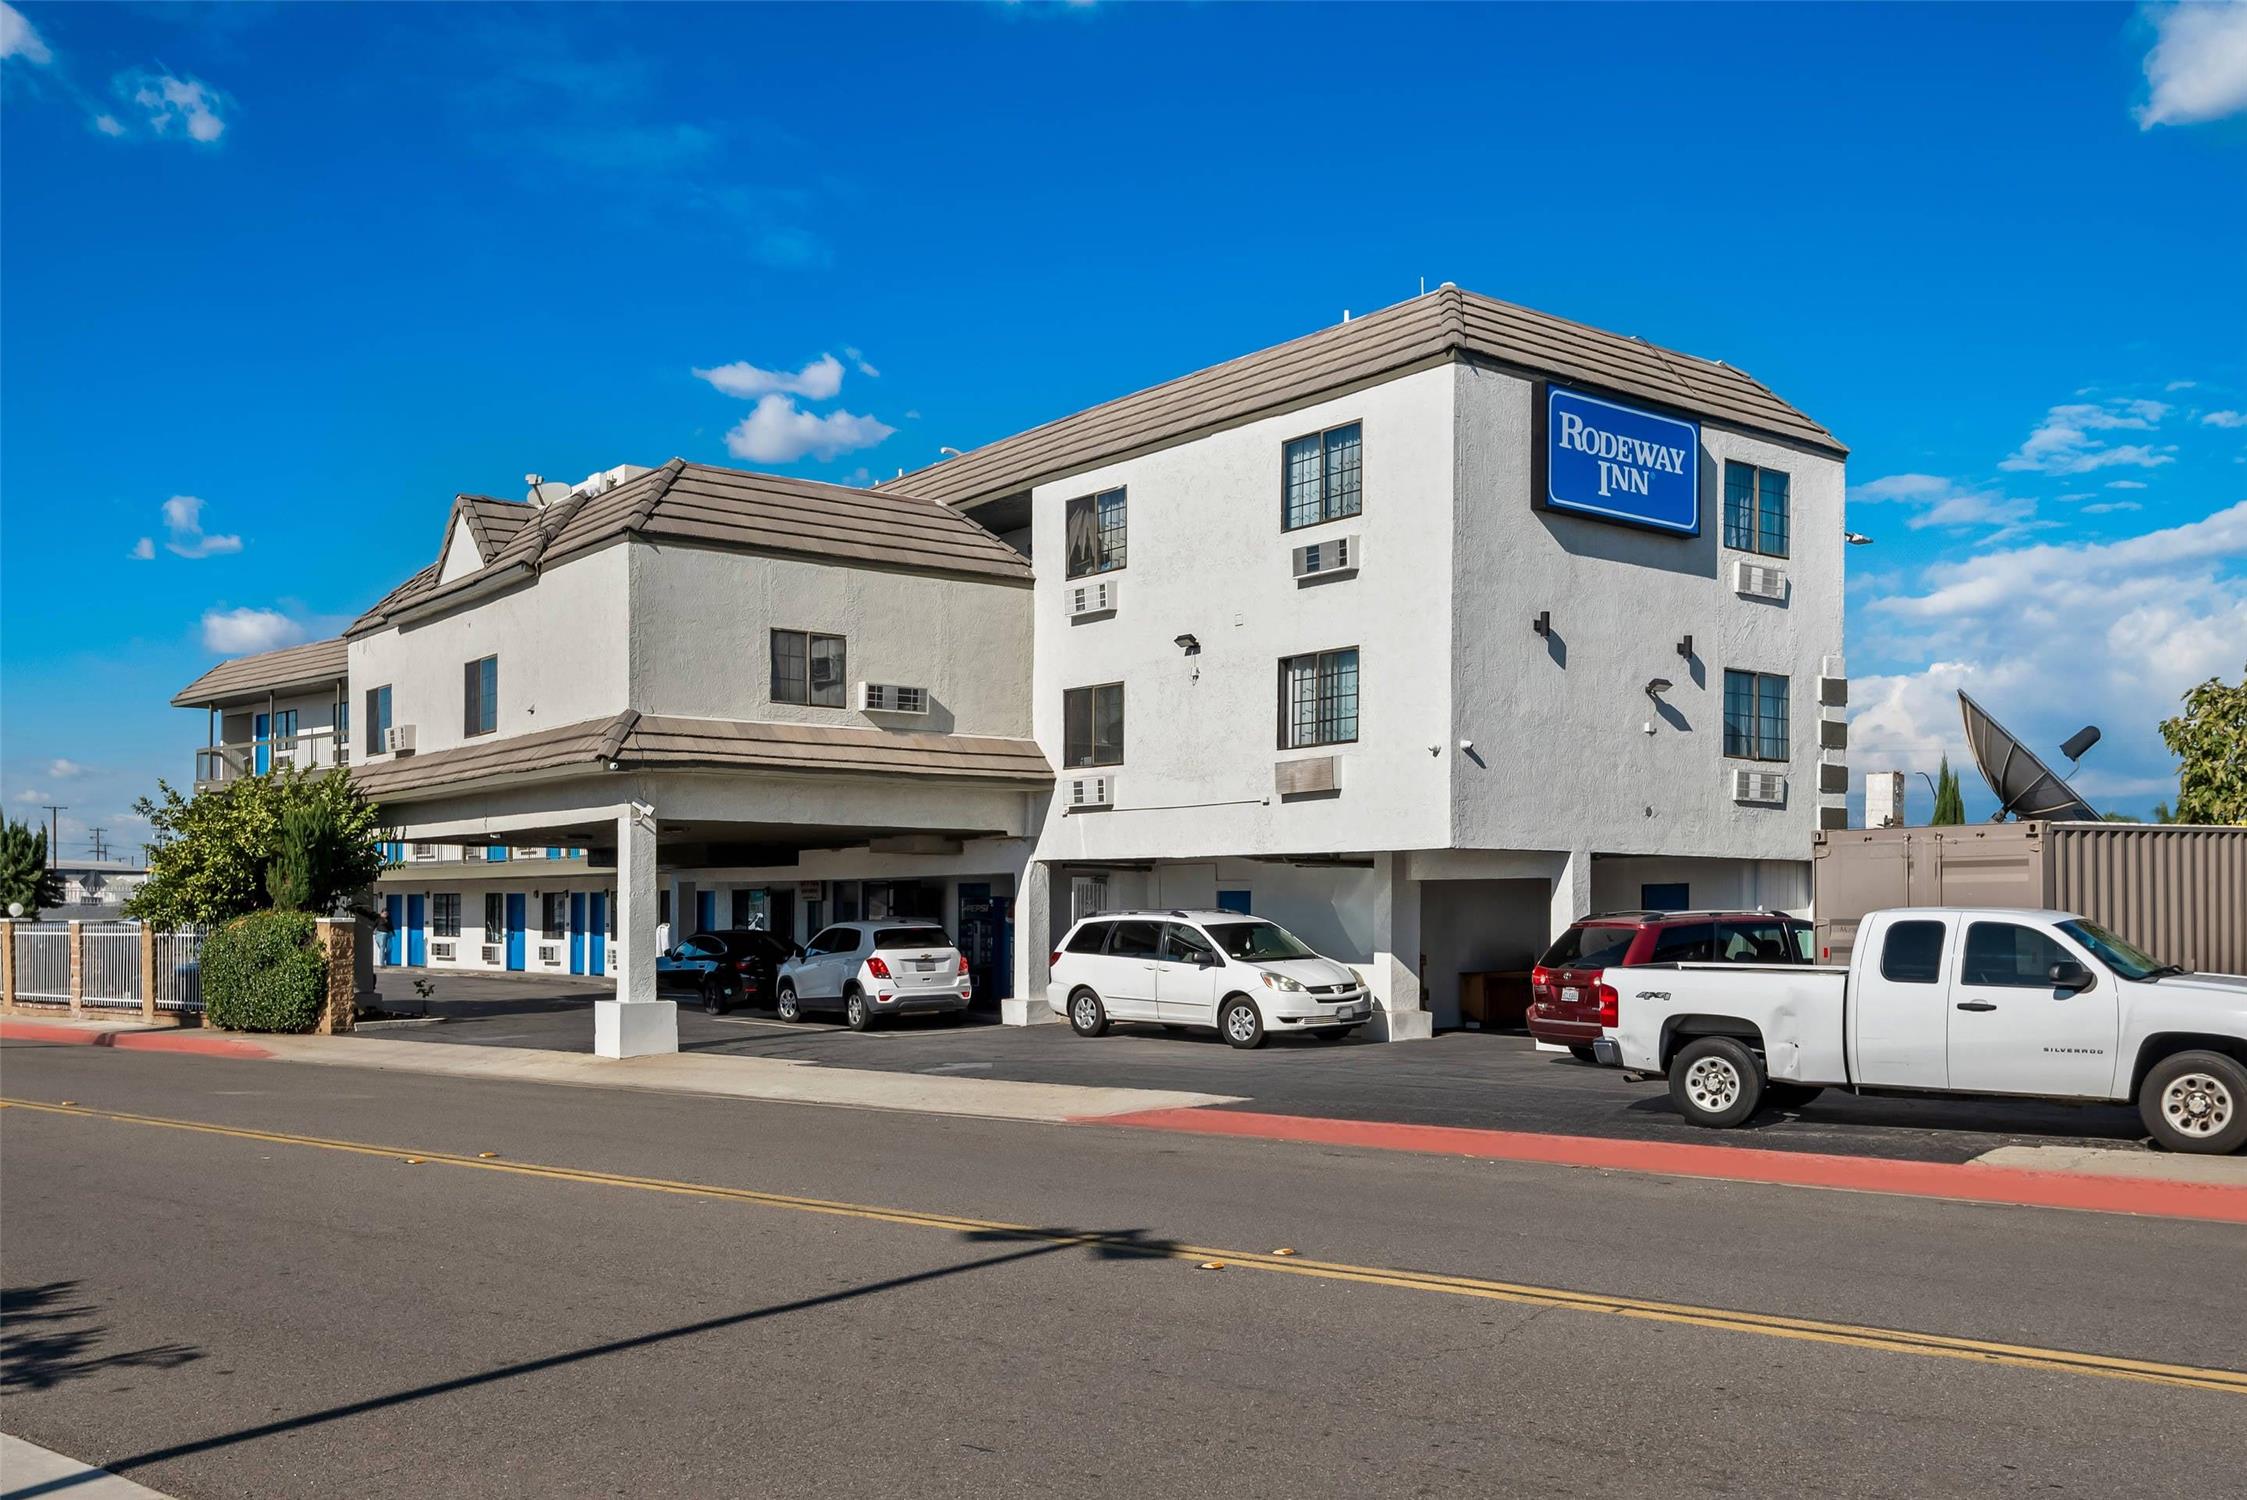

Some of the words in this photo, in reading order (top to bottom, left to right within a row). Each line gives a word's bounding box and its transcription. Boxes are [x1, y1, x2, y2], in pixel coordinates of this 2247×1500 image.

[1559, 411, 1686, 475] RODEWAY
[1598, 460, 1649, 497] INN
[2043, 1047, 2104, 1055] SILVERADO
